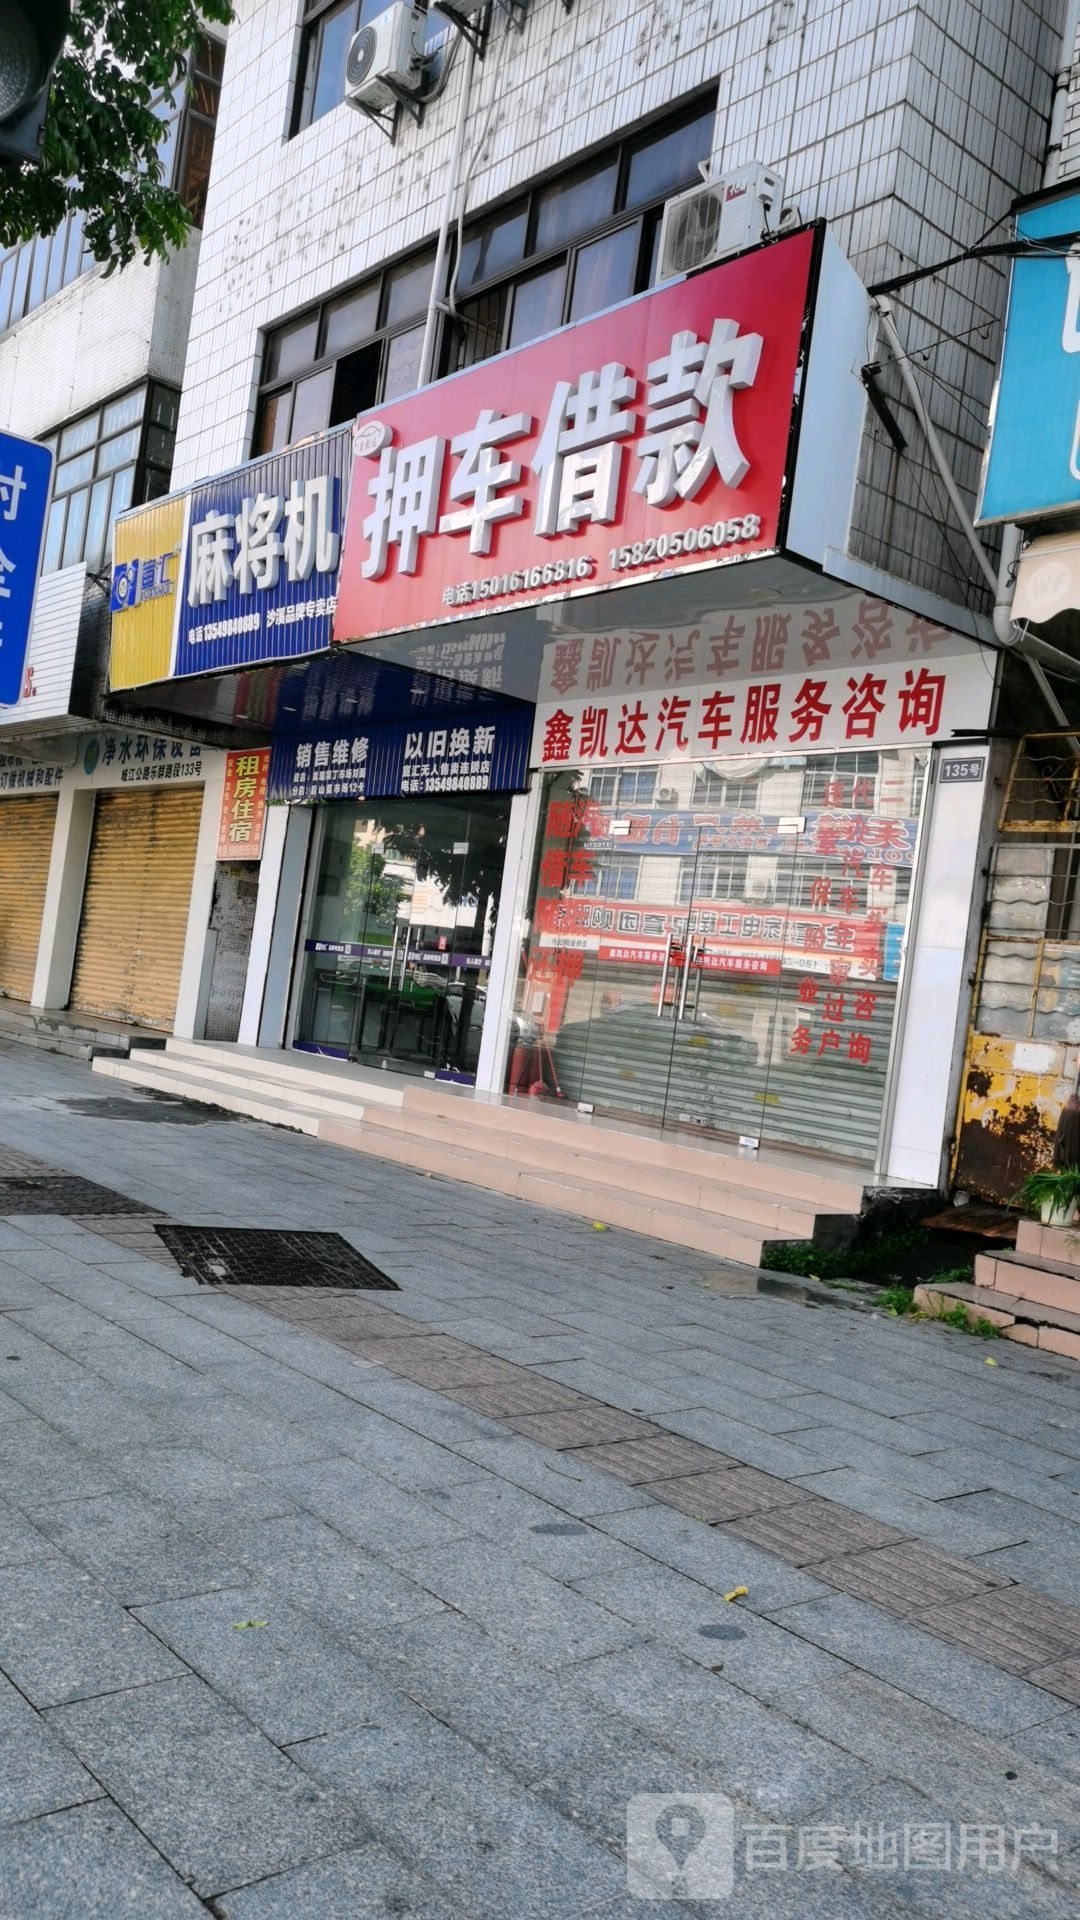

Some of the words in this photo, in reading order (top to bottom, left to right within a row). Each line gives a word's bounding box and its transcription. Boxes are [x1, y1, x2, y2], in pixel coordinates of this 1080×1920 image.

[362, 318, 763, 581] 押车借款
[188, 473, 340, 608] 麻将机
[442, 556, 595, 606] 电话15016166816
[608, 514, 761, 571] 15820506058
[266, 595, 338, 628] 沙溪品牌专卖店
[541, 667, 946, 763] 鑫凯达汽车服务咨询
[295, 736, 369, 769] 销售维修
[404, 725, 496, 760] 以旧换新
[402, 759, 491, 777] 宣汇无人售卖连锁店
[944, 763, 981, 777] 135号
[228, 755, 261, 843] 租房住宿
[609, 948, 672, 964] 鑫凯达汽车服务咨
[697, 955, 768, 972] 凯达汽车服务咨询
